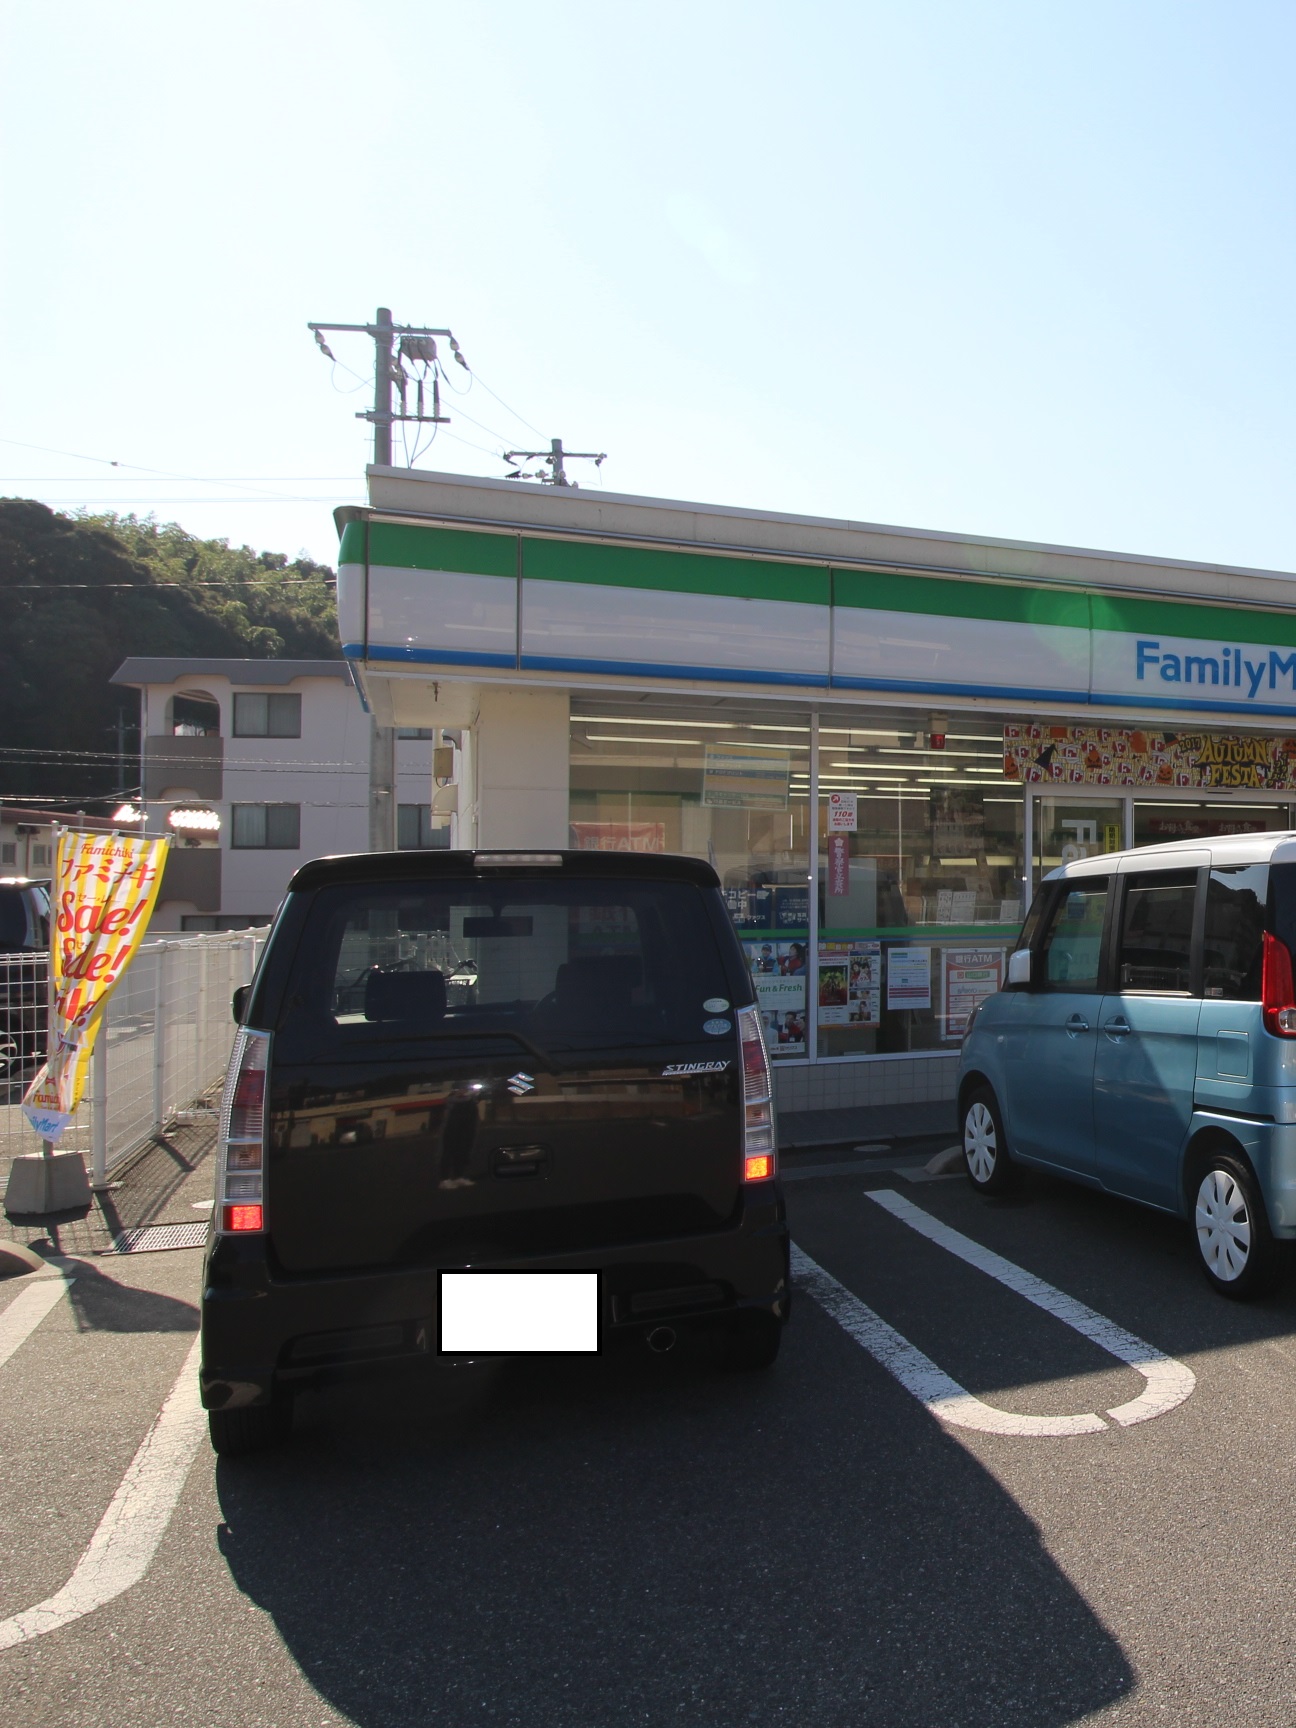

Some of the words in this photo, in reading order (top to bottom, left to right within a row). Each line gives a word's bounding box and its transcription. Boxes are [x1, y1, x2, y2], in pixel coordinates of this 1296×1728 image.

[1180, 739, 1200, 751] 2017
[1194, 735, 1270, 766] AUTUMN
[1206, 764, 1263, 788] FESTA
[81, 843, 135, 859] Famichiki
[62, 859, 157, 889] ファミチキ
[57, 890, 149, 937] Sae!
[755, 985, 771, 993] Fun
[779, 984, 803, 992] Fresh
[665, 1060, 731, 1072] STINGRAY
